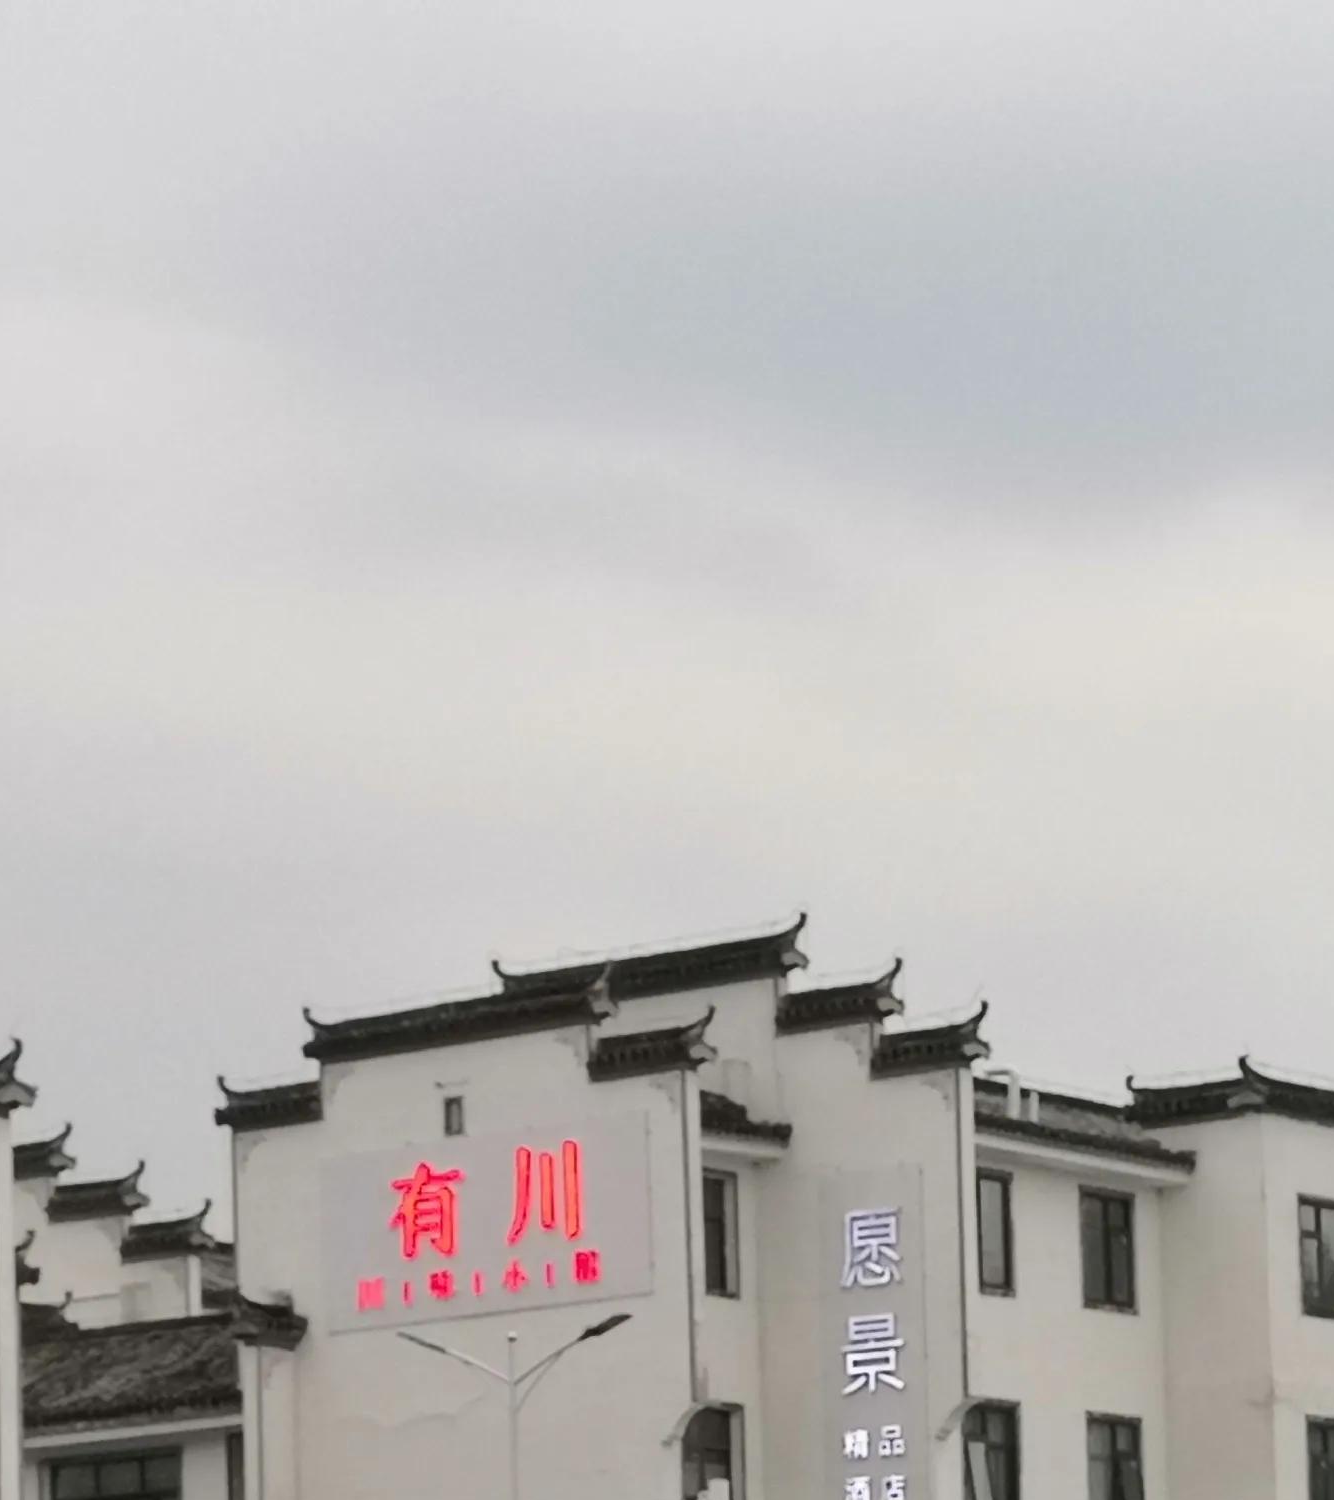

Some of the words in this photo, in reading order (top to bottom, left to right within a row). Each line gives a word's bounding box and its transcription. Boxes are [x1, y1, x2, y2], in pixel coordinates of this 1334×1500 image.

[388, 1140, 581, 1259] 有川
[840, 1207, 906, 1396] 愿景
[842, 1424, 906, 1460] 精品
